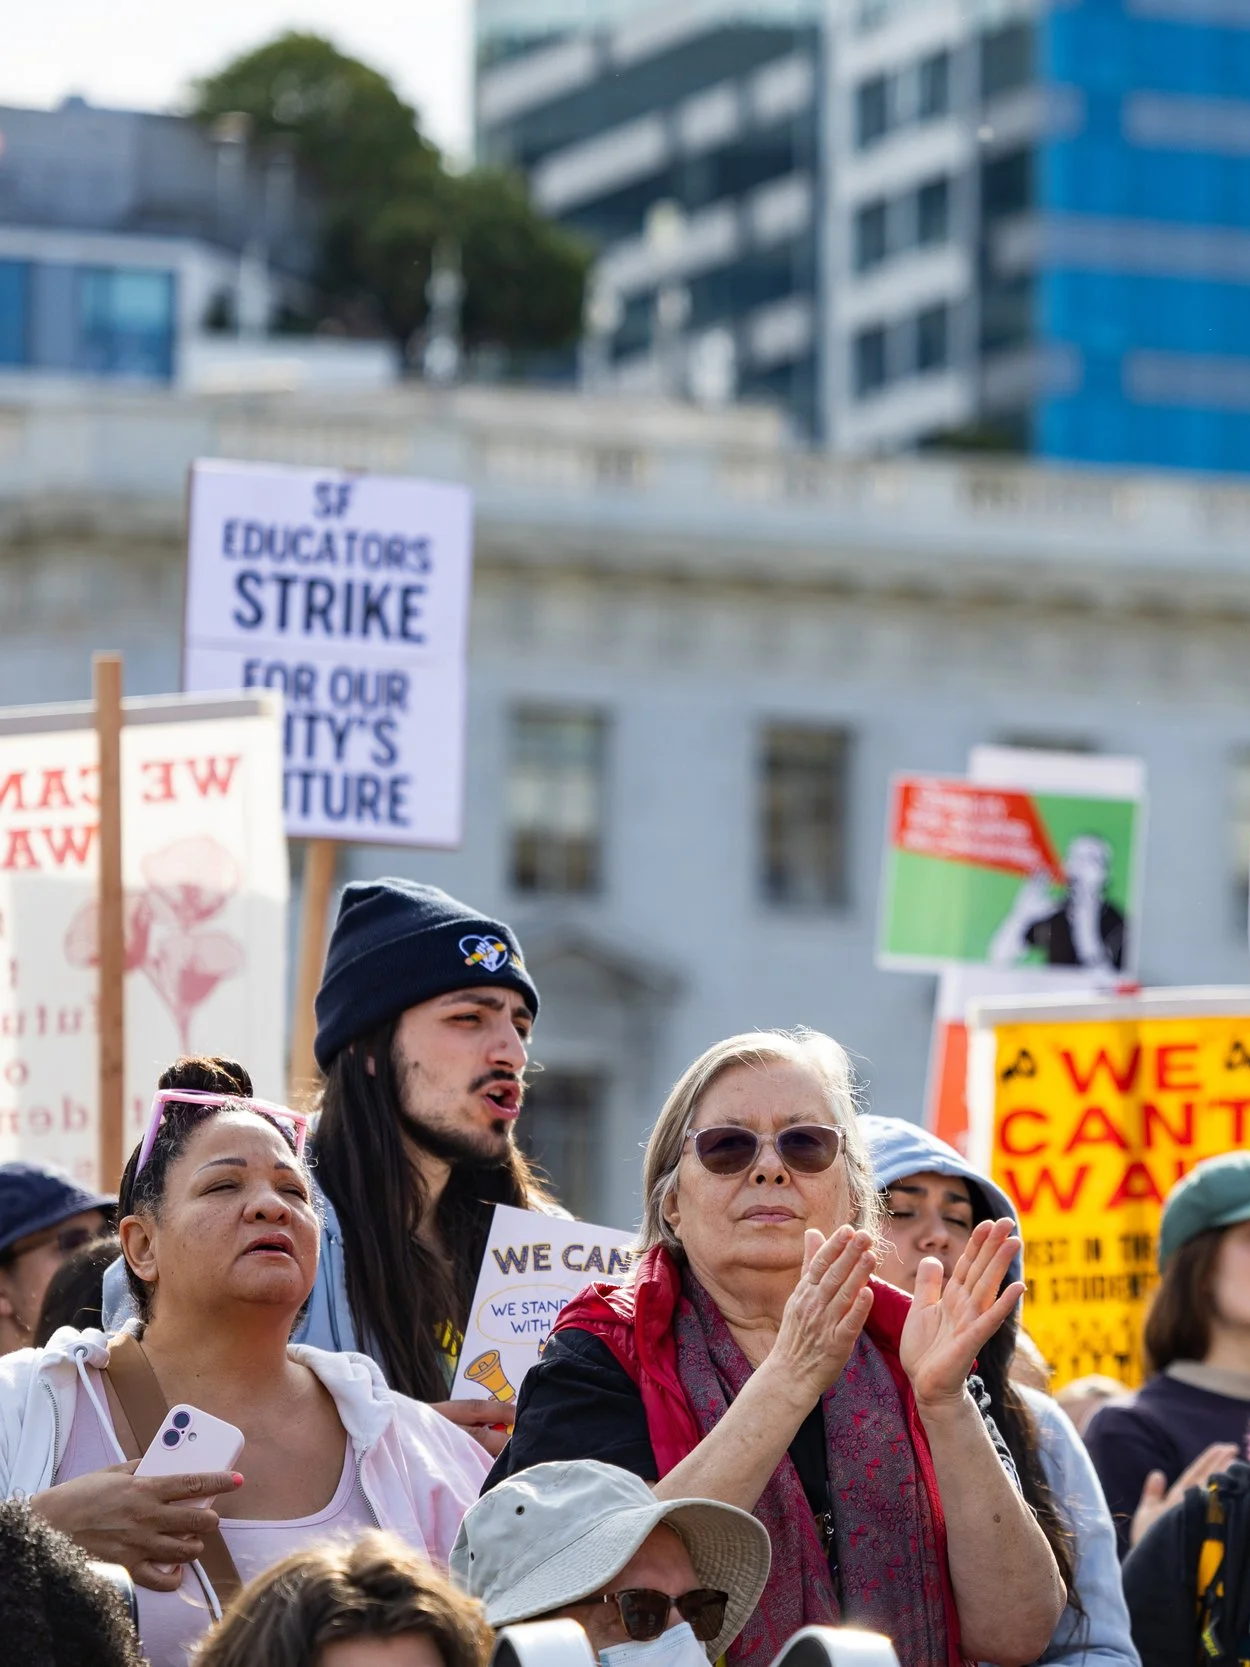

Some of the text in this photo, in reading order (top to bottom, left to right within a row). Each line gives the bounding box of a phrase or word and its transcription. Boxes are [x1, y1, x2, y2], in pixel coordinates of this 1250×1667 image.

[314, 481, 351, 518] SF
[222, 518, 432, 575] EDUCATORS
[232, 569, 427, 645] STRIKE
[328, 666, 411, 710] OUR
[284, 709, 399, 767] ITY'S
[283, 768, 413, 827] TURE
[1057, 1043, 1202, 1095] WE
[492, 1244, 552, 1275] WE
[490, 1299, 570, 1317] WE STAND
[510, 1318, 551, 1334] WITH
